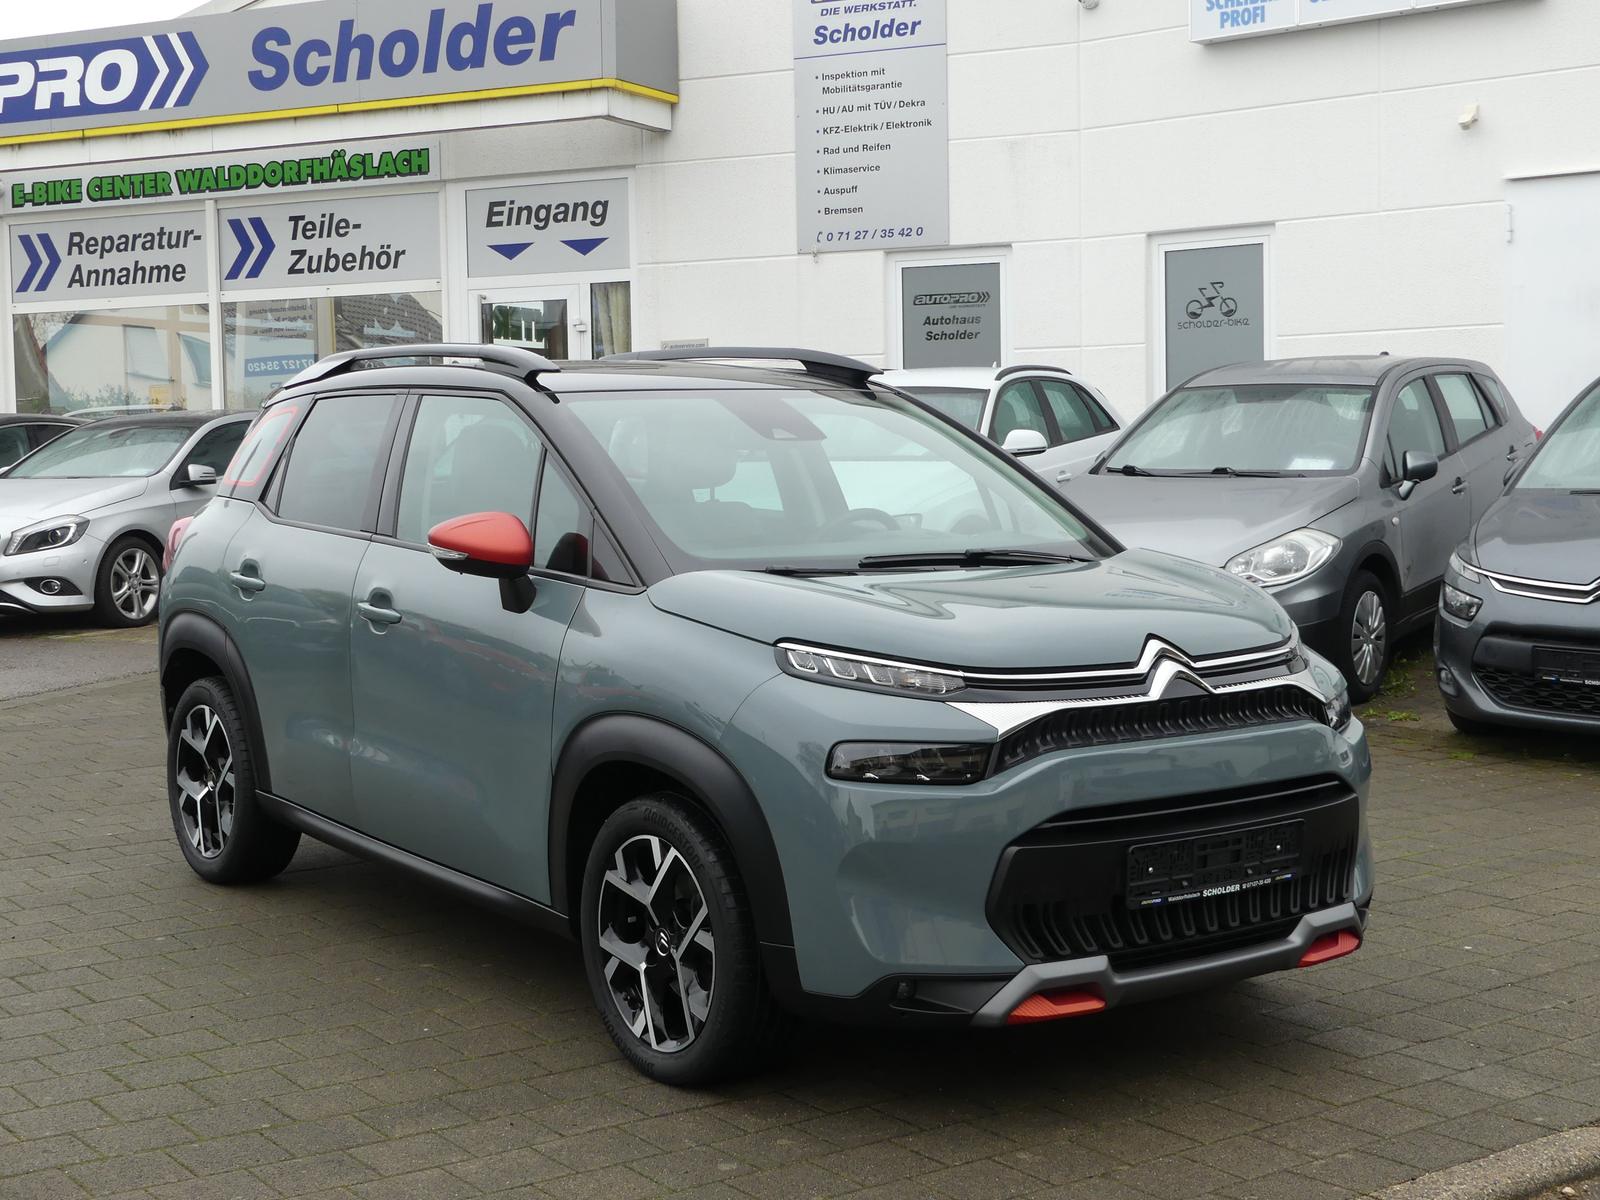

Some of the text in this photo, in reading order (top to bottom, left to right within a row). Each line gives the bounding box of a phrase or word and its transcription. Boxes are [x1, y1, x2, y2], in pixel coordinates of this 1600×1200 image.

[820, 7, 840, 17] DIE
[1219, 5, 1266, 29] PROFI
[813, 18, 922, 46] Scholder
[247, 2, 577, 92] Scholder
[821, 67, 886, 82] Inspektion mit
[822, 80, 903, 95] Mobilitätsgarantie
[856, 103, 871, 112] mit
[823, 142, 892, 156] Rad und Reifen
[823, 163, 881, 176] Klimaservice
[11, 147, 430, 209] E-BIKE CENTER WALDDORFHÄSLACH
[823, 185, 858, 196] Auspuff
[485, 199, 609, 231] Eingang
[824, 206, 864, 216] Bremsen
[288, 212, 362, 242] Teile-
[67, 226, 202, 259] Reparatur-
[287, 244, 406, 276] Zubehör
[67, 262, 187, 289] Annahme
[923, 314, 982, 327] Autohaus
[925, 329, 981, 342] Scholder
[1203, 883, 1240, 897] SCHOLDER
